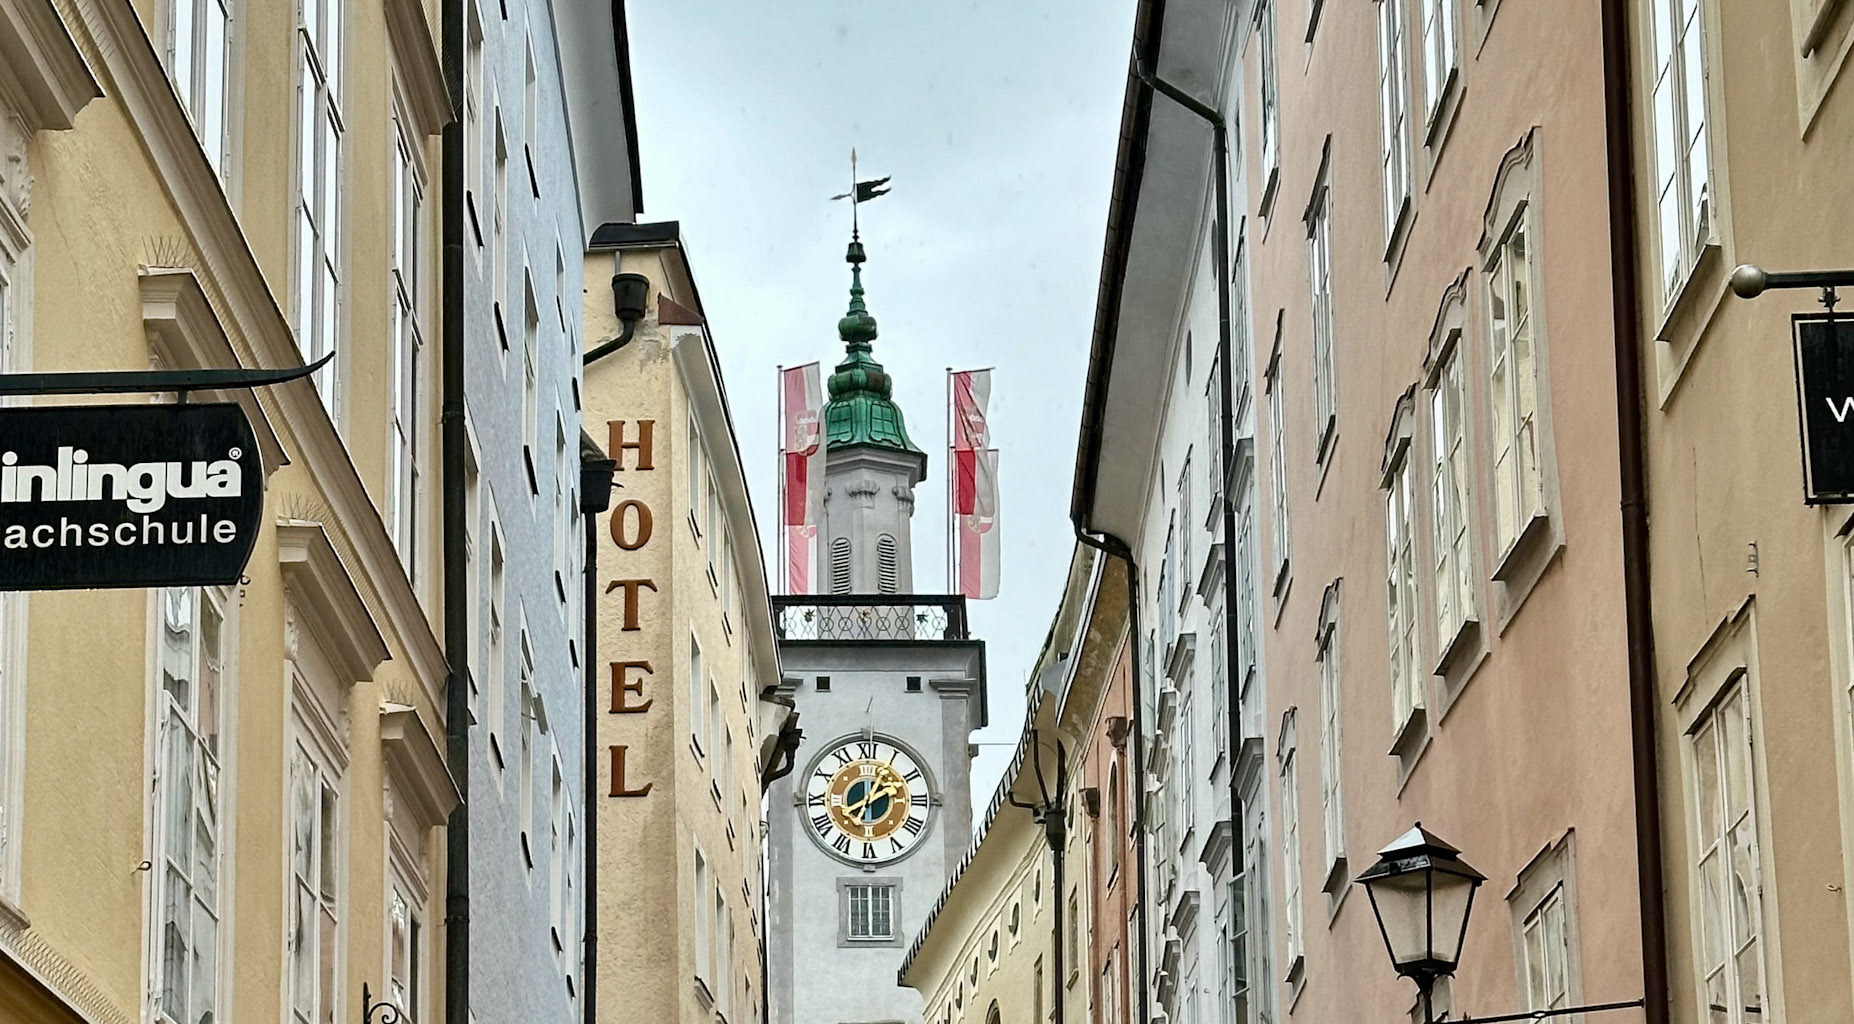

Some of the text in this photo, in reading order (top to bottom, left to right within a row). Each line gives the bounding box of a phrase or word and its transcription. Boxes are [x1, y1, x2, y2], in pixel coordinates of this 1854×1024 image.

[0, 446, 242, 514] inlingua
[4, 513, 237, 549] achschule
[606, 419, 656, 798] HOTEL
[832, 747, 853, 768] XI
[857, 743, 878, 760] XII
